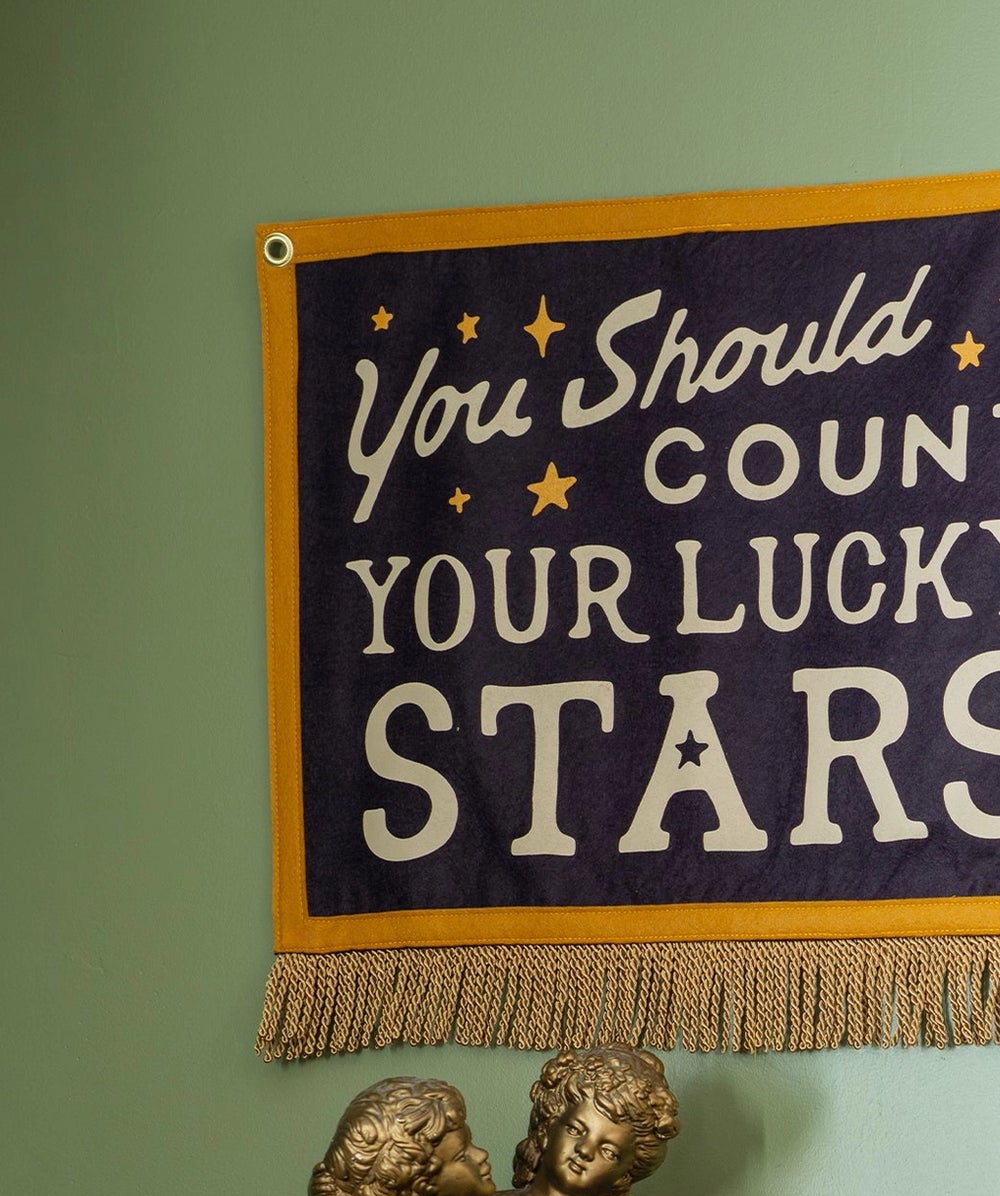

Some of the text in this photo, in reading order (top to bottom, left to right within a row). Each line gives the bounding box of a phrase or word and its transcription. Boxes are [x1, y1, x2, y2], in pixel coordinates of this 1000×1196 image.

[347, 264, 932, 523] You Should
[346, 544, 650, 655] YOUR
